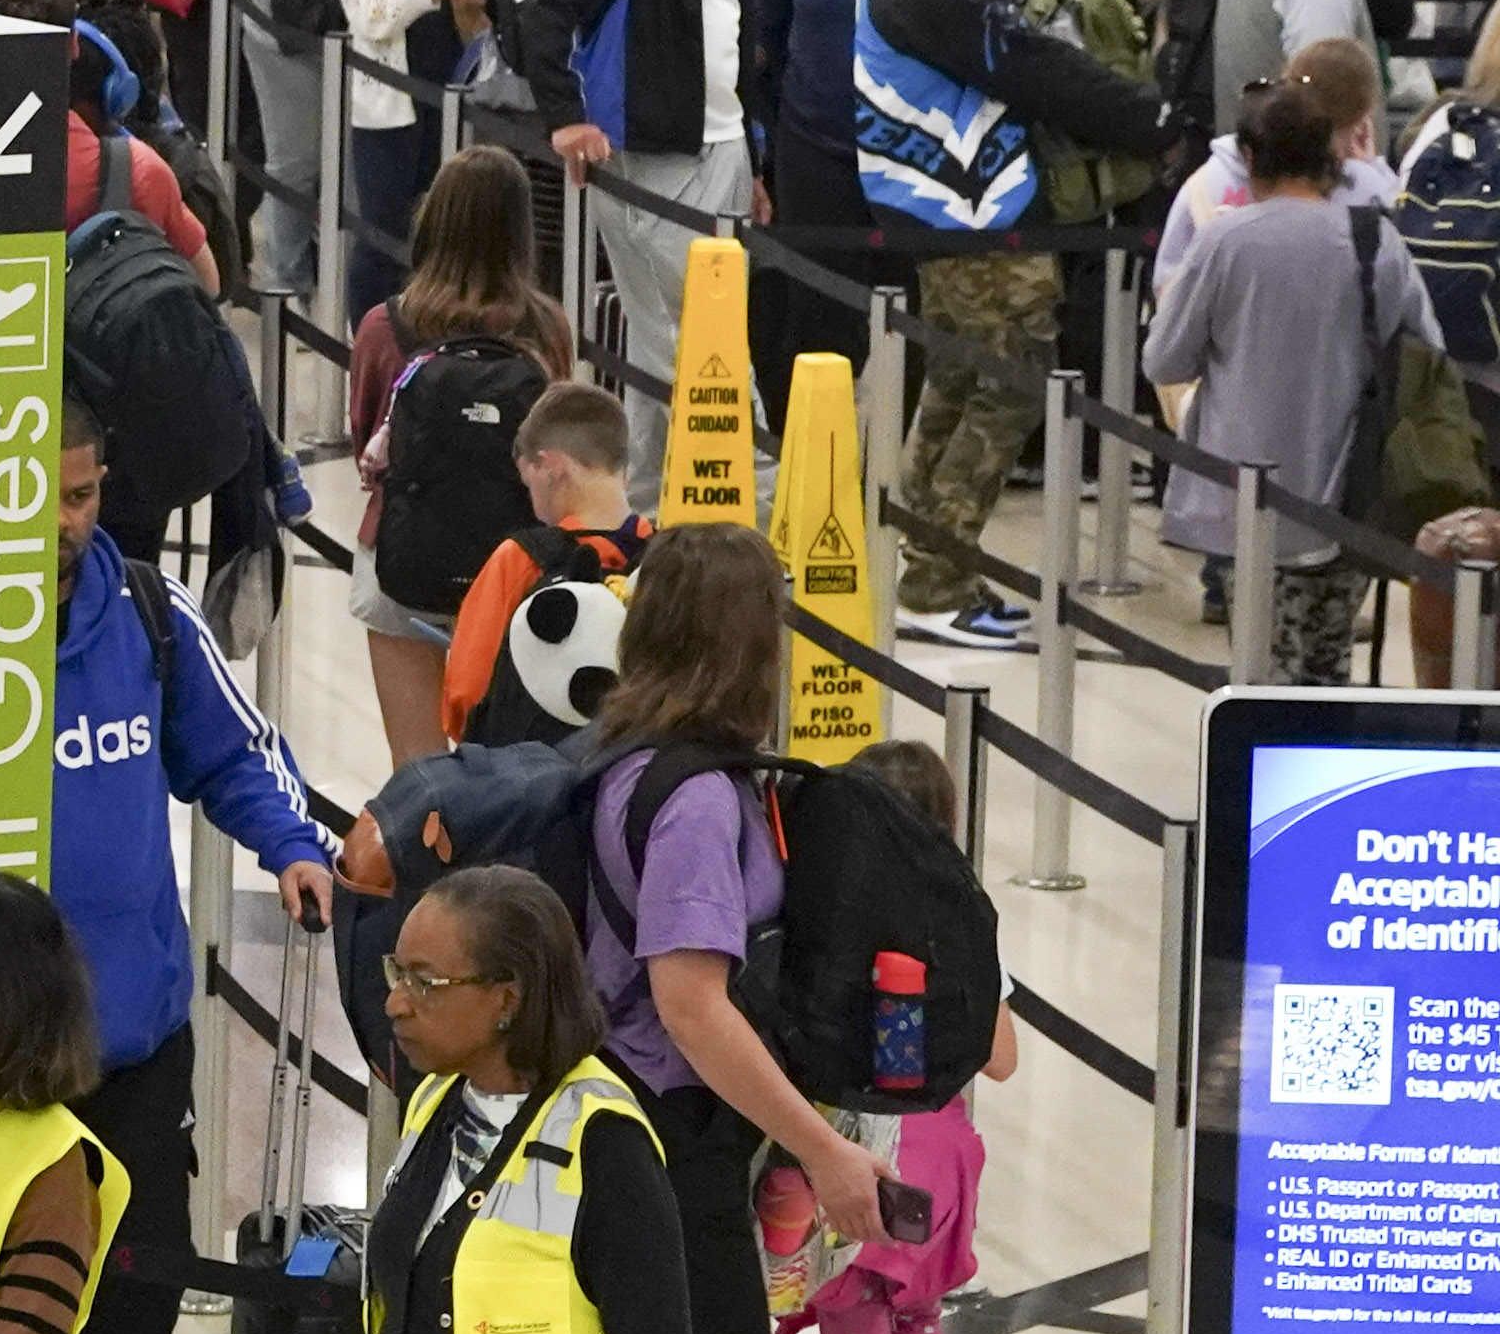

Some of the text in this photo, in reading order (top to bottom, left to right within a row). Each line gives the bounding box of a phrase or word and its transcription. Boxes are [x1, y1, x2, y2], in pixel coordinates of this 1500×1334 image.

[689, 386, 739, 406] CAUTION
[687, 415, 740, 434] CUIDADO
[692, 460, 733, 480] WET
[681, 485, 741, 508] FLOOR
[811, 664, 850, 678] WET
[801, 679, 863, 697] FLOOR
[810, 706, 854, 722] PISO
[792, 723, 872, 740] MOJADO
[1356, 828, 1452, 864] Don't
[1327, 914, 1500, 952] of Identifi
[1407, 996, 1500, 1019] Scan the
[1407, 1022, 1444, 1045] the
[1448, 1022, 1491, 1047] $45
[1406, 1048, 1443, 1071] fee
[1446, 1051, 1471, 1072] or
[1267, 1140, 1366, 1163] Acceptable
[1368, 1143, 1426, 1164] Forms
[1428, 1144, 1451, 1163] of
[1279, 1176, 1500, 1201] U.S. Passport or Passport
[1278, 1199, 1312, 1219] U.S.
[1315, 1200, 1422, 1223] Department
[1425, 1203, 1448, 1223] of
[1277, 1224, 1318, 1243] DHS
[1319, 1224, 1389, 1244] Trusted
[1391, 1226, 1467, 1247] Traveler
[1276, 1247, 1326, 1267] REAL
[1328, 1248, 1350, 1268] ID
[1351, 1250, 1374, 1268] or
[1376, 1249, 1464, 1271] Enhanced
[1276, 1271, 1473, 1295] Enhanced Tribal Cards
